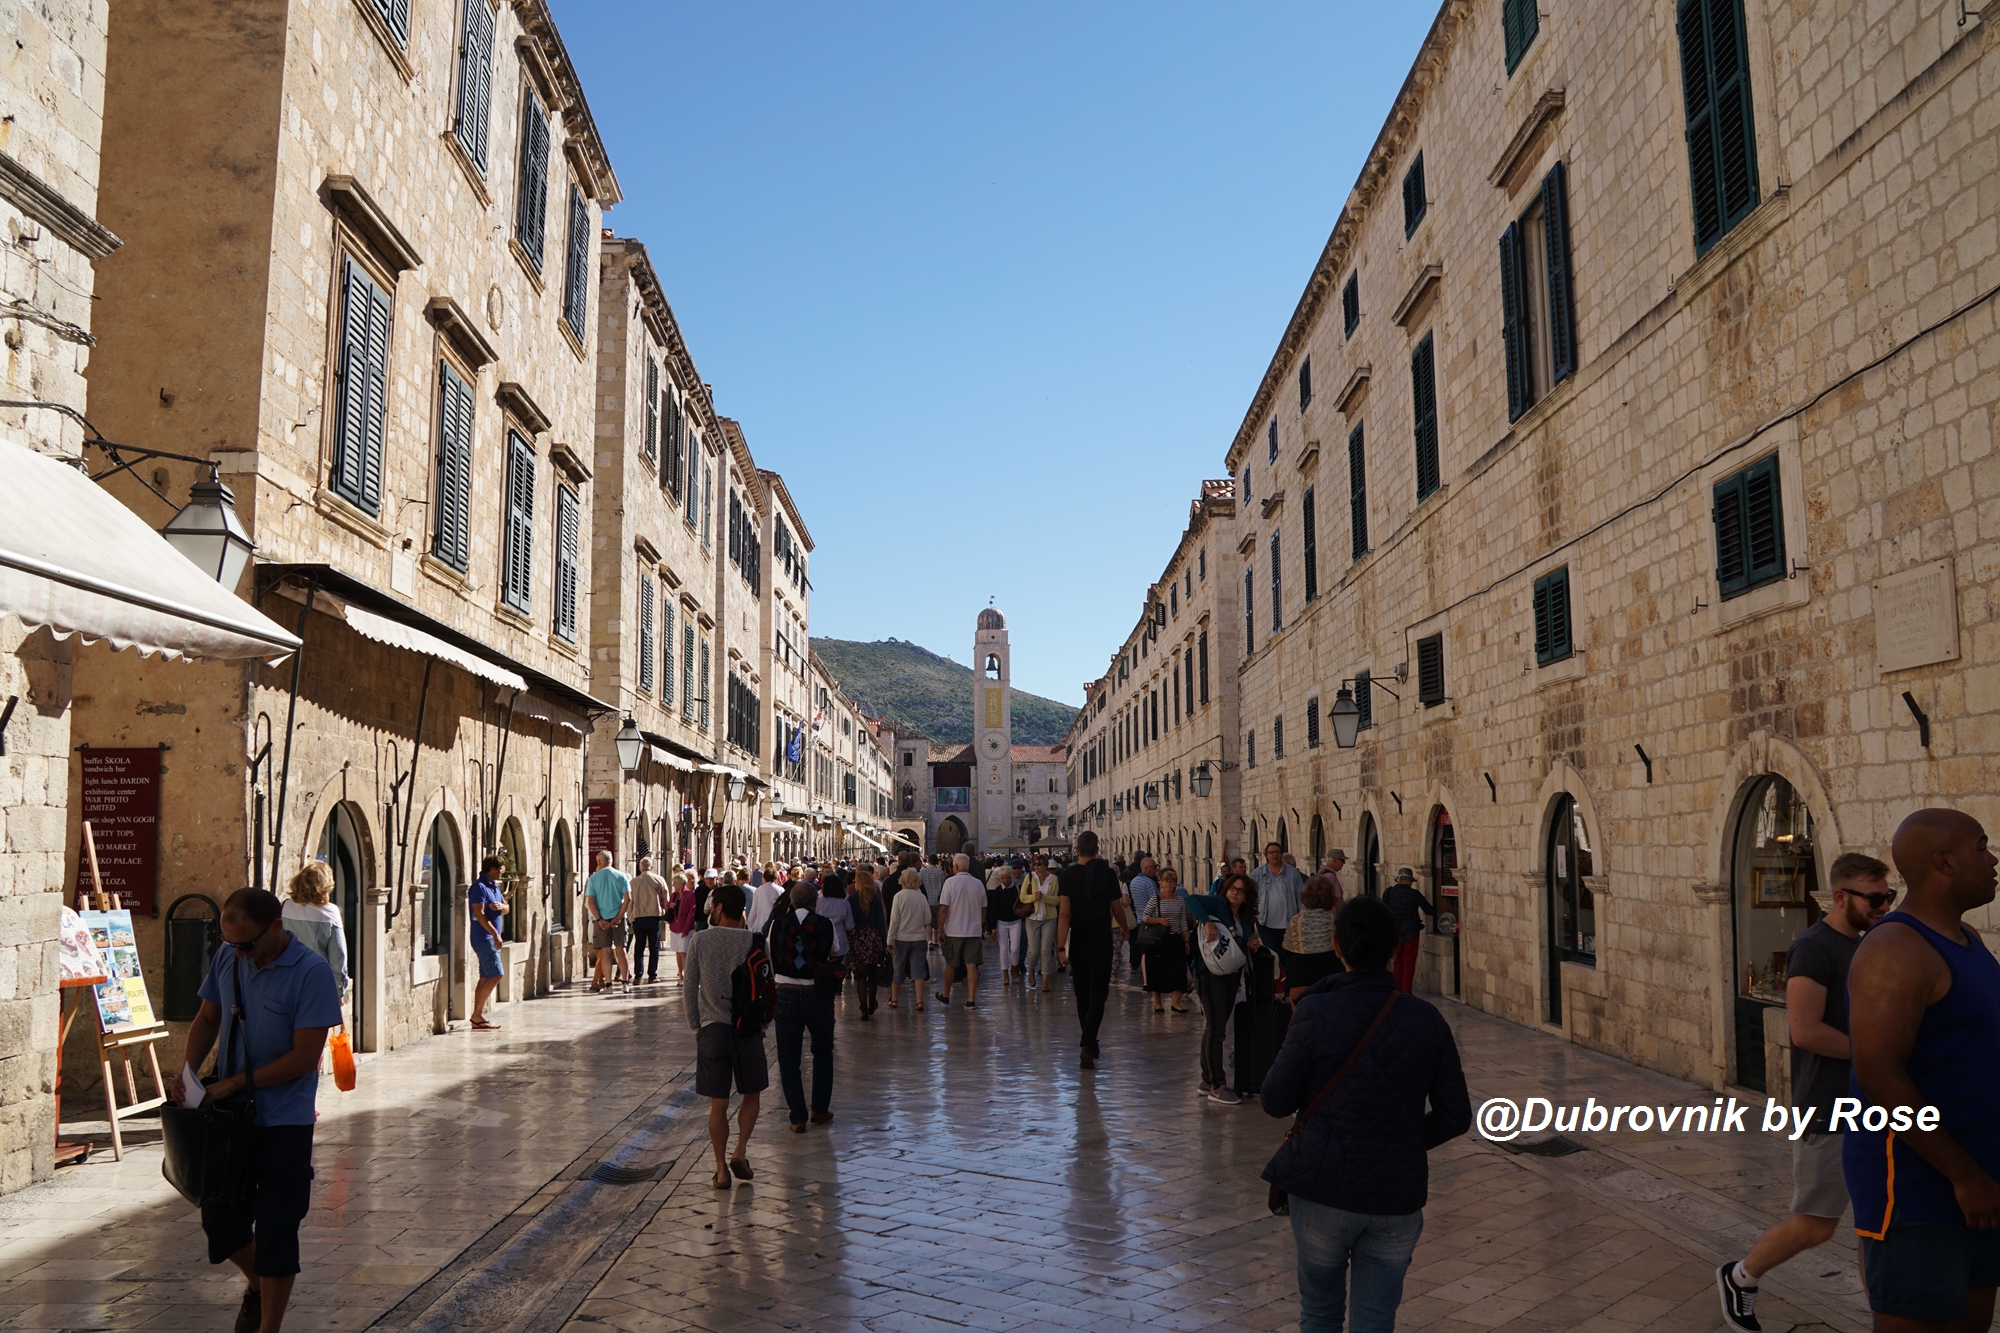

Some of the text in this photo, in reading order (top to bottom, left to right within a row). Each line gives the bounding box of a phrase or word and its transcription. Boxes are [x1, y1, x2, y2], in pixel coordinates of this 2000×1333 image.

[104, 756, 131, 764] ŠKOLA
[84, 765, 114, 773] sandwich
[85, 777, 99, 786] light
[101, 777, 118, 785] lunch
[101, 816, 116, 825] shop
[113, 857, 142, 865] PALACE
[1213, 934, 1230, 960] NIKE
